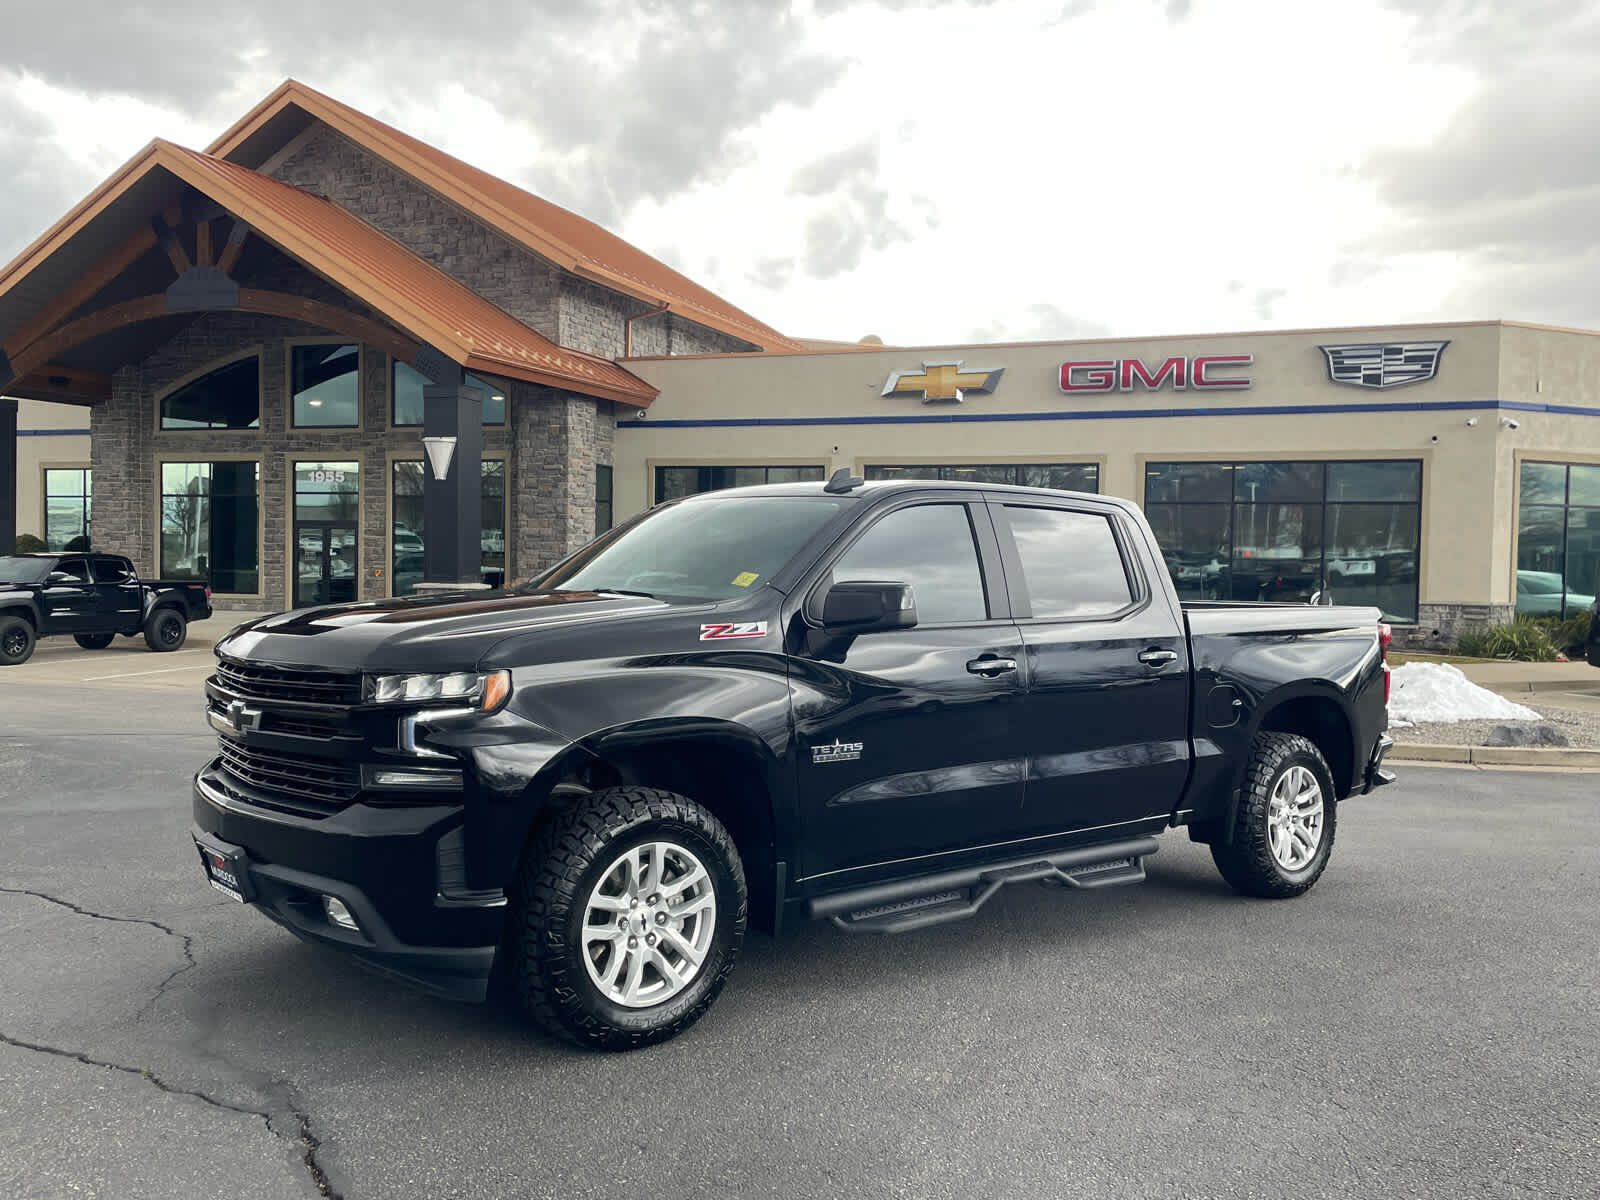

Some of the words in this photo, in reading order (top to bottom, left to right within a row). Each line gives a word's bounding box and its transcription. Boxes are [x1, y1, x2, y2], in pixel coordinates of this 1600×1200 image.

[1059, 353, 1254, 393] GMC
[308, 470, 345, 483] 1955
[700, 621, 768, 641] Z71
[811, 739, 863, 754] TEXAS
